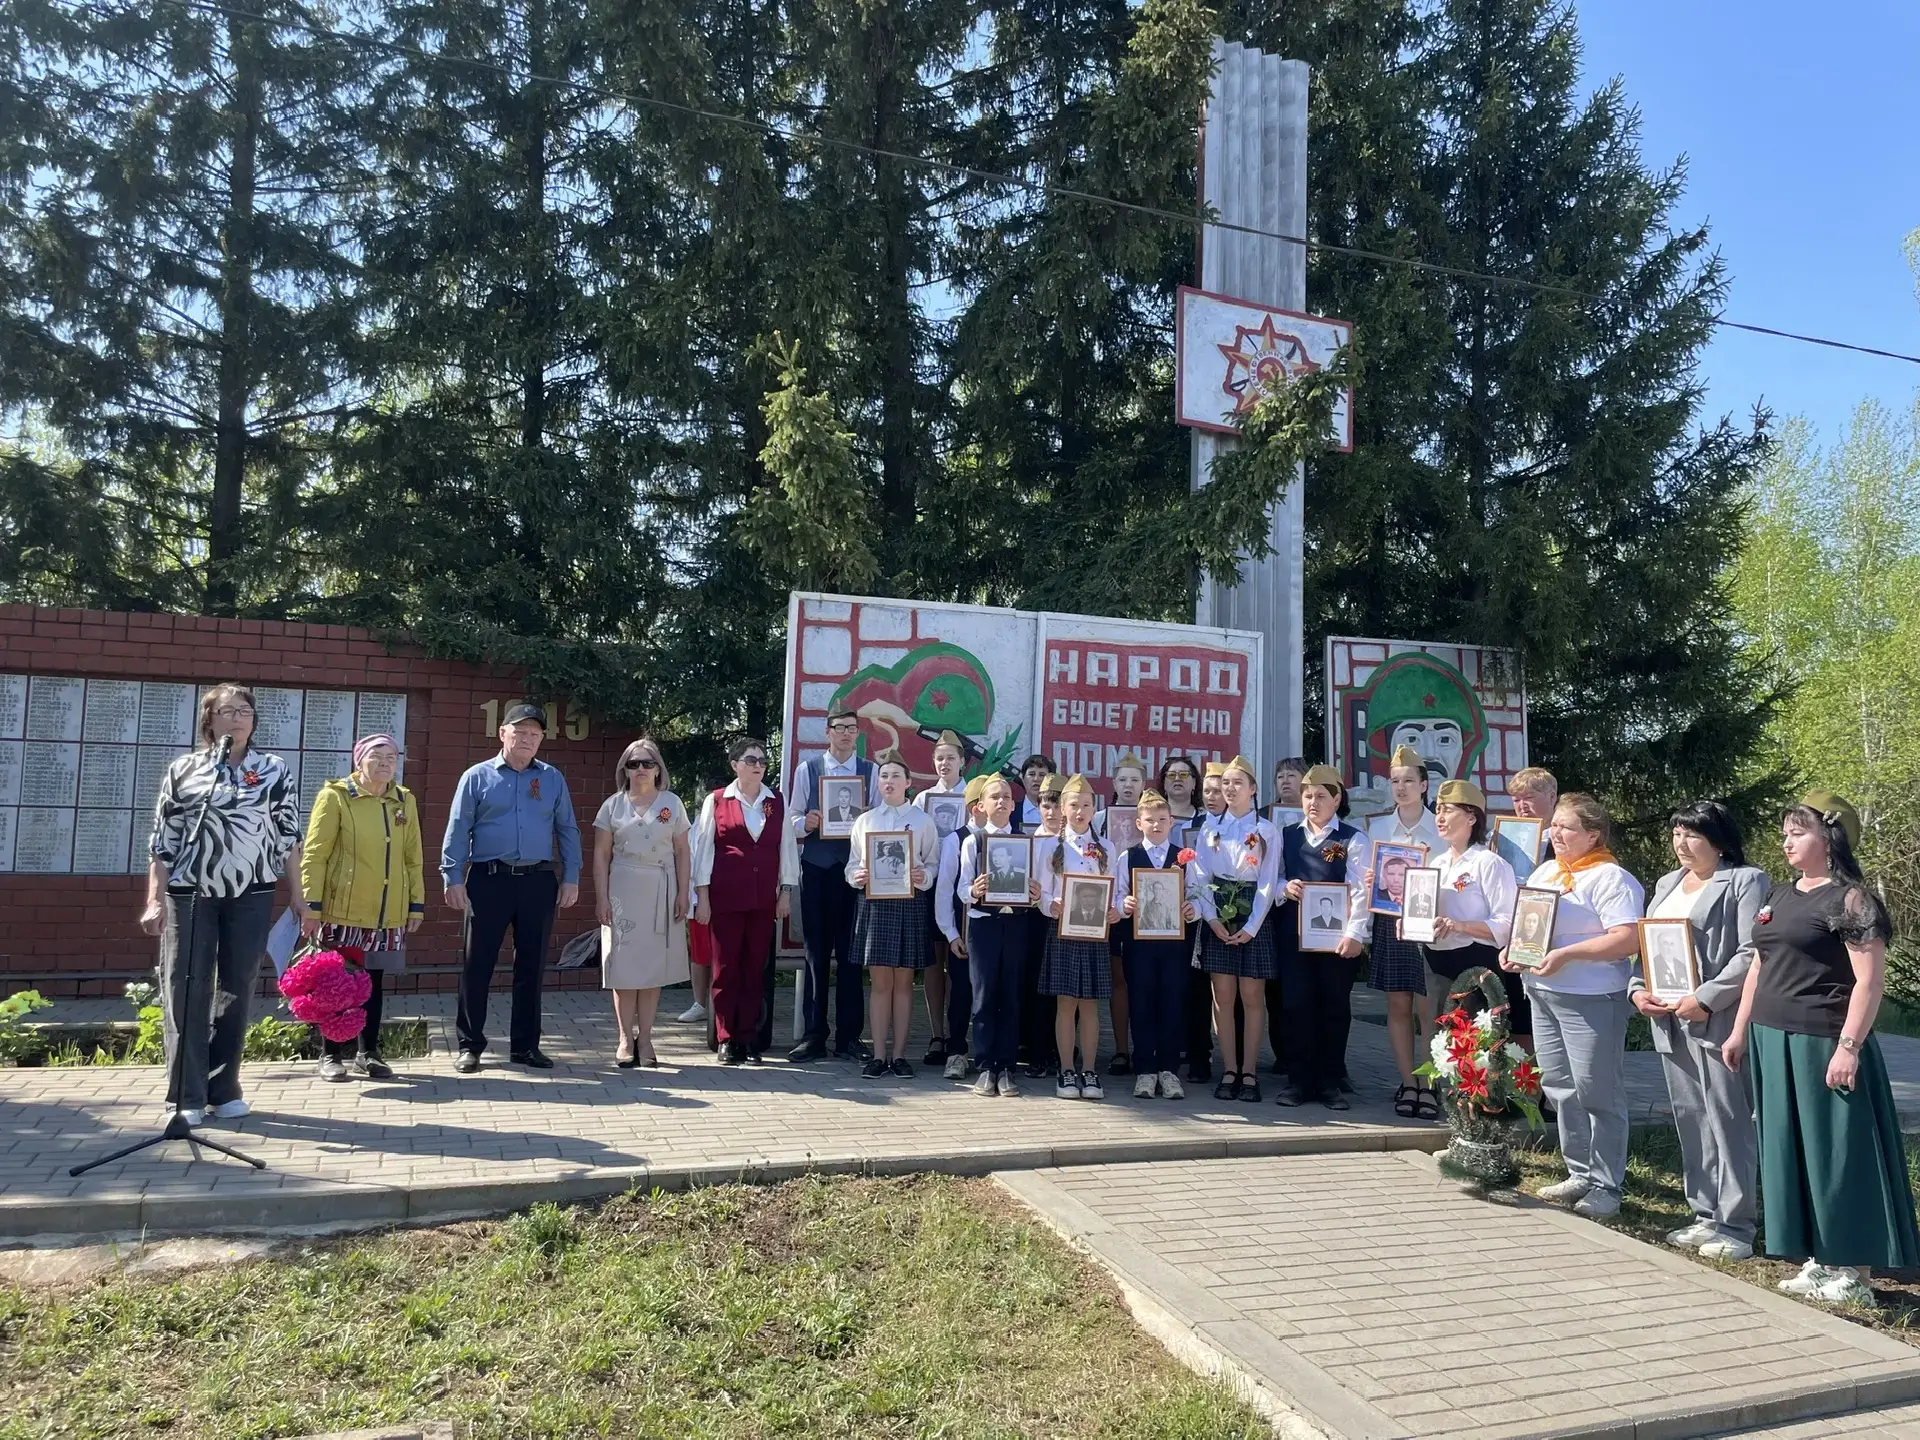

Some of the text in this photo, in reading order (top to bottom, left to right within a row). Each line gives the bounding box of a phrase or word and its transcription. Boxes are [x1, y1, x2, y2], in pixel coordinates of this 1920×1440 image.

[1048, 649, 1241, 696] НАРОД
[480, 699, 590, 741] 145
[1053, 698, 1231, 736] БУДЕТ ВЕЧНО
[1053, 741, 1222, 780] ПОМНИТ
